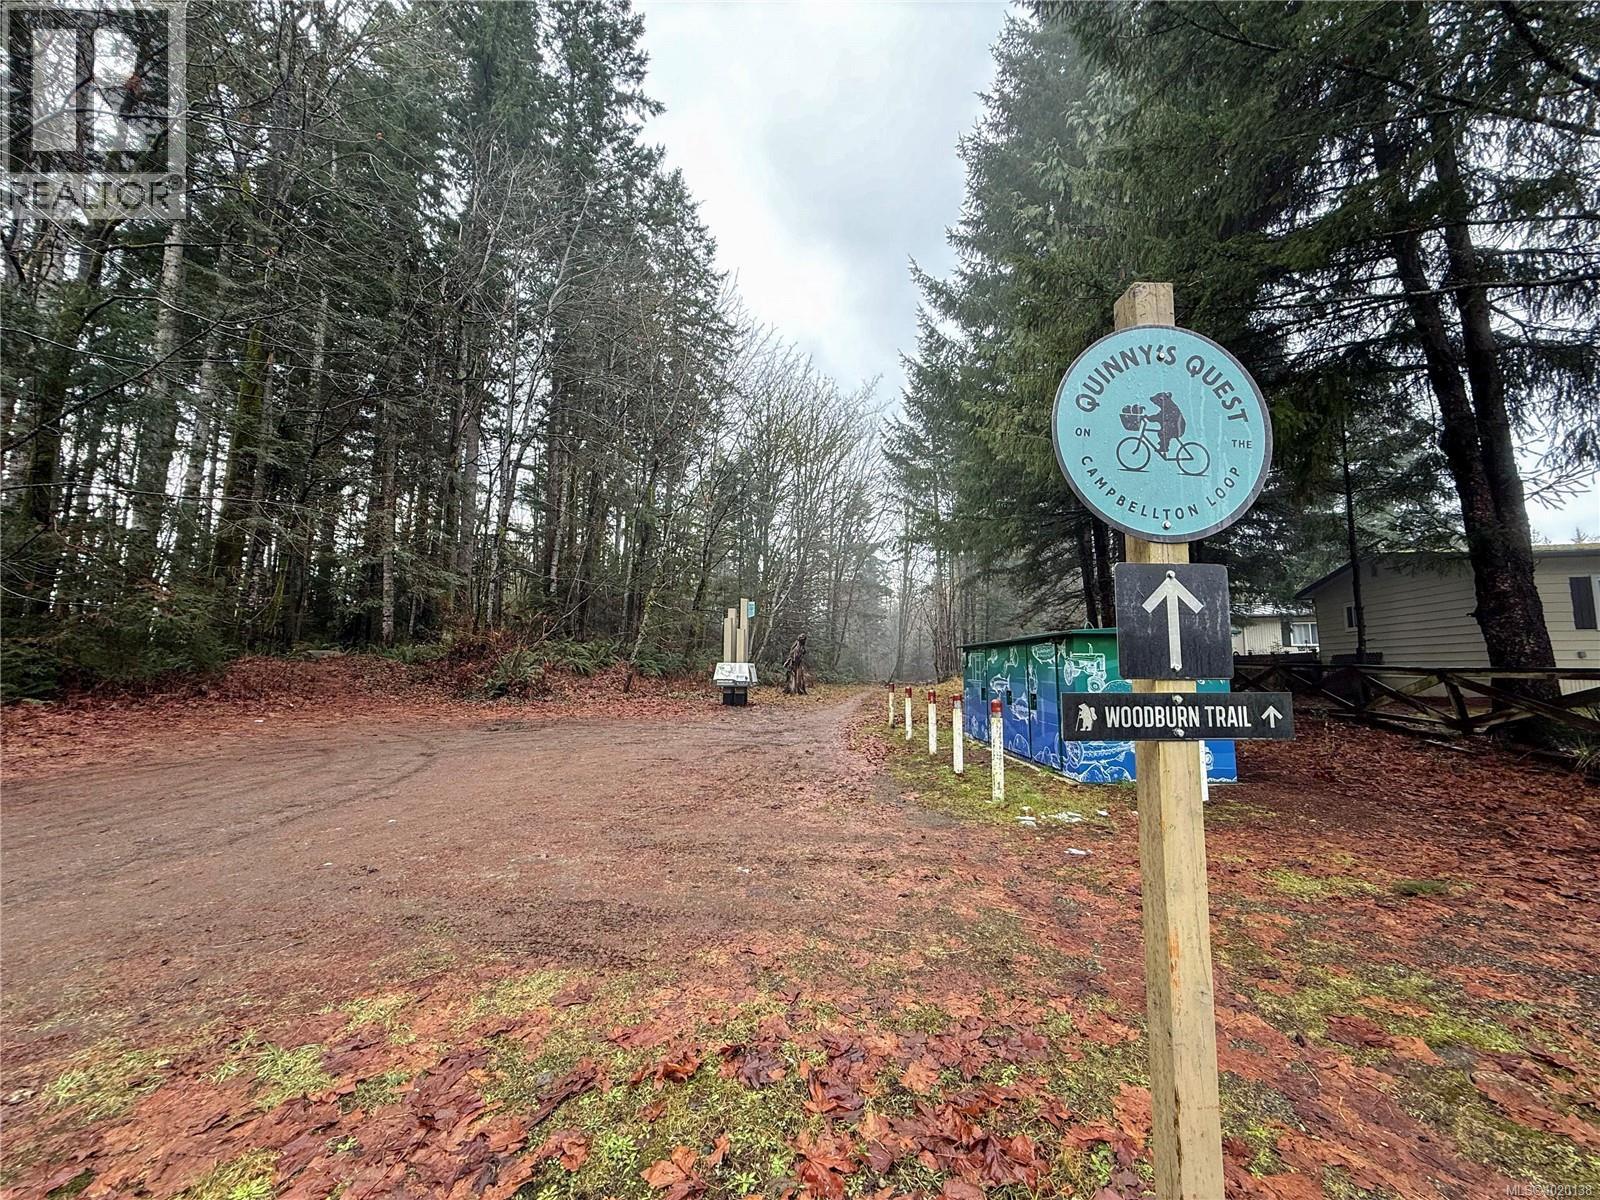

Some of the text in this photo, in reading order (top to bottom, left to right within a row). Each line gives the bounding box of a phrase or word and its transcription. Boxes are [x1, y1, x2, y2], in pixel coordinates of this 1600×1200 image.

[1075, 344, 1249, 424] QUINNY'S QUEST
[1075, 427, 1252, 449] ON THE
[1081, 455, 1240, 521] CAMPBELLTON LOOP
[1104, 705, 1252, 728] WOODBURN TRAIL
